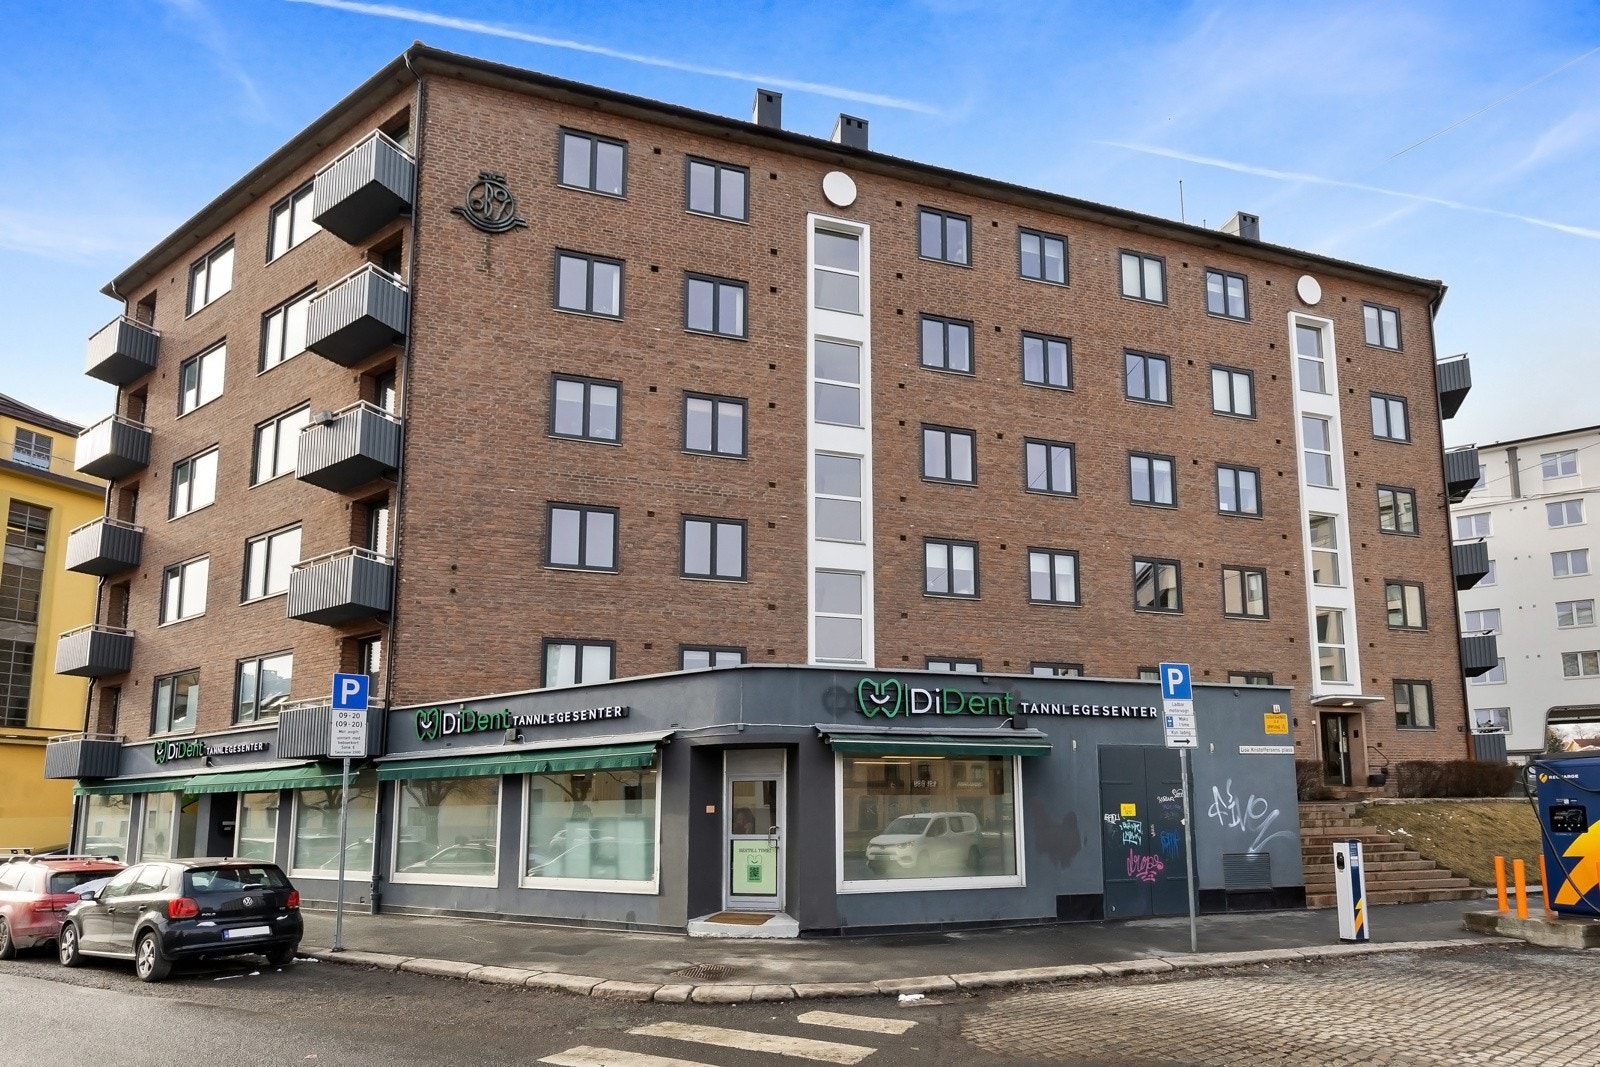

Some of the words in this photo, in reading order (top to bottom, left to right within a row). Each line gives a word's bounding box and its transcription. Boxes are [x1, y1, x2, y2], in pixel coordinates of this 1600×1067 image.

[341, 678, 360, 704] P
[1168, 668, 1183, 695] P
[911, 688, 1014, 715] DiDent
[1021, 702, 1158, 717] TANNLEGESENTER
[443, 708, 511, 734] DiDent
[513, 705, 622, 726] TANNLEGESENTER
[168, 741, 205, 760] DiDent
[206, 742, 263, 756] TANNLEGESENTER
